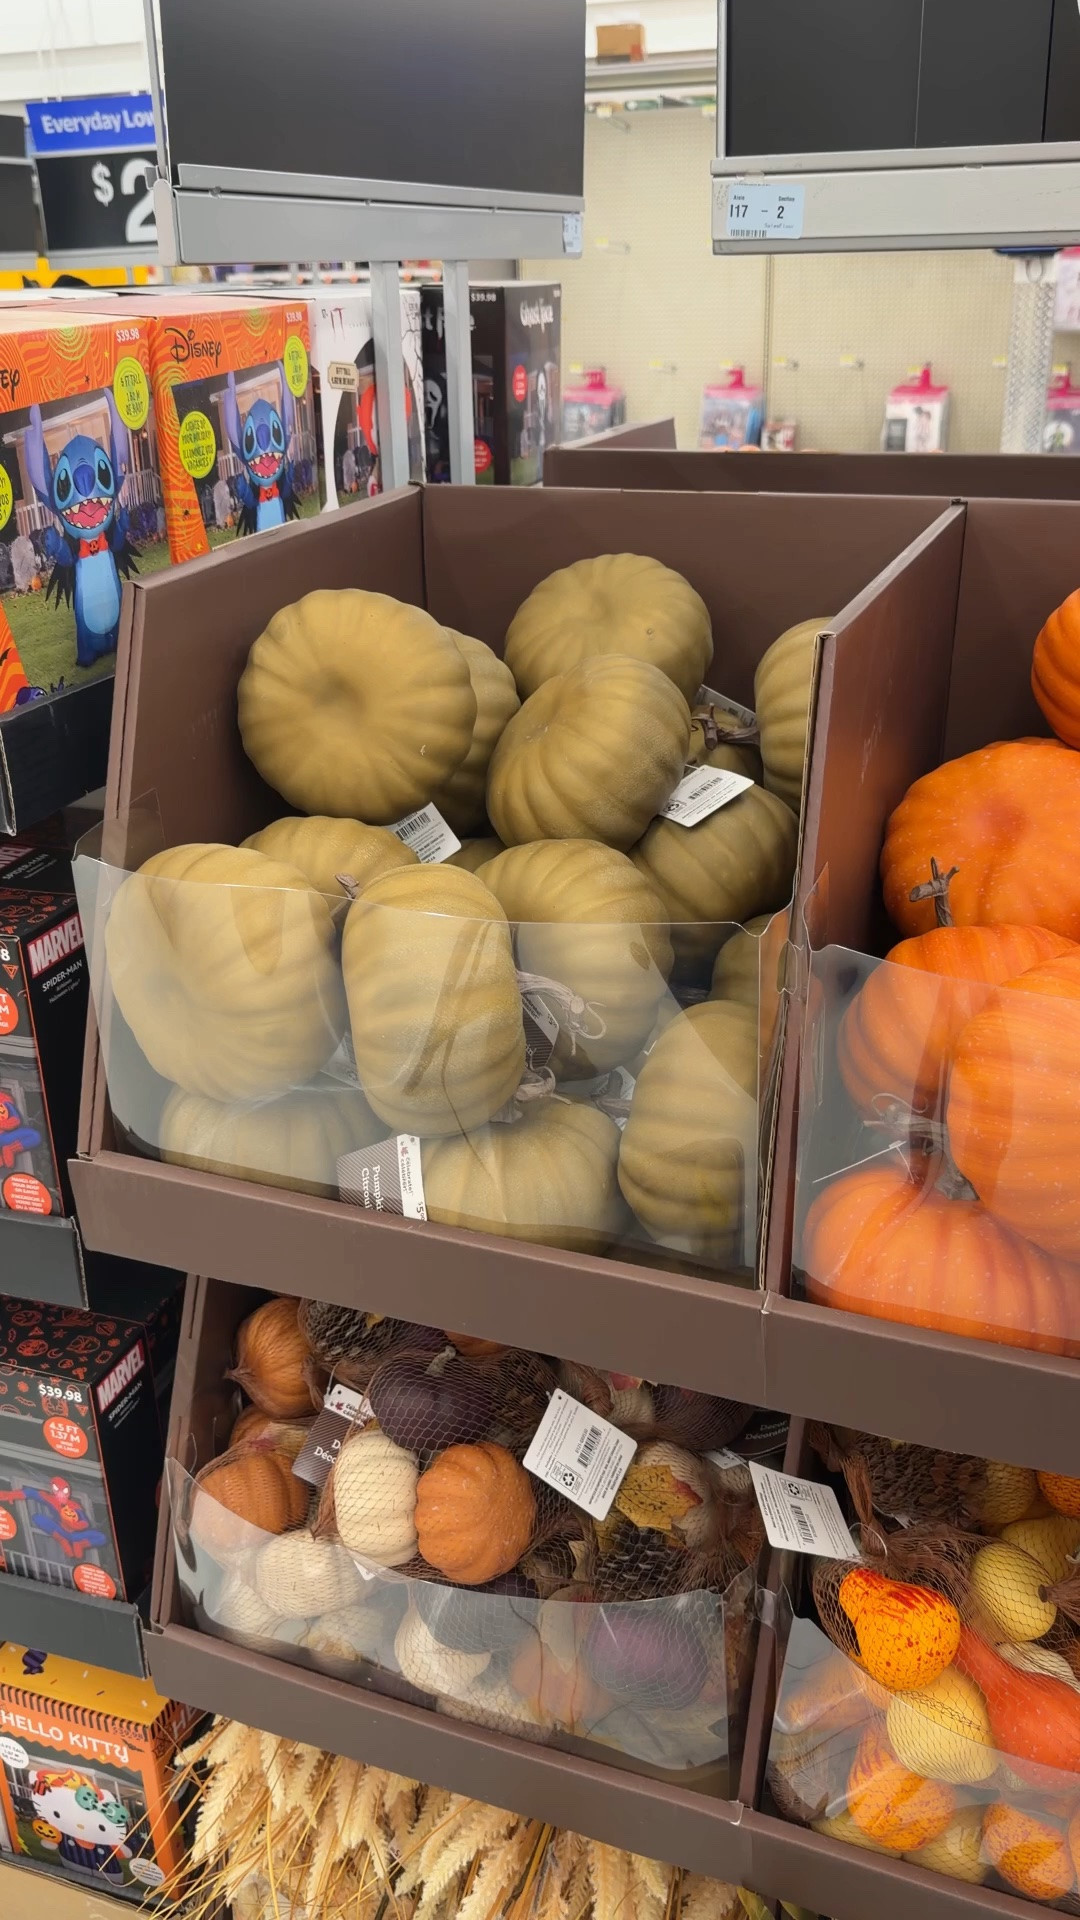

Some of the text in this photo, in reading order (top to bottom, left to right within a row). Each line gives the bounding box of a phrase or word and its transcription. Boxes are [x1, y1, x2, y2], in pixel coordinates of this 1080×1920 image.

[41, 110, 121, 135] Everyday
[776, 205, 785, 219] 2
[470, 292, 497, 302] $39.98
[115, 328, 140, 343] $39.98
[28, 914, 84, 975] MARVEL
[42, 959, 83, 993] SPIDER-MAN
[361, 1167, 373, 1209] Citroui
[372, 1164, 384, 1212] Pumpki
[97, 1343, 145, 1412] MARVEL
[38, 1383, 82, 1403] $39.98
[108, 1380, 143, 1422] SPIDER-MAN
[49, 1421, 78, 1434] 4.5 FT
[50, 1429, 80, 1443] 1.37 M
[1, 1709, 129, 1763] HELLO KITTY
